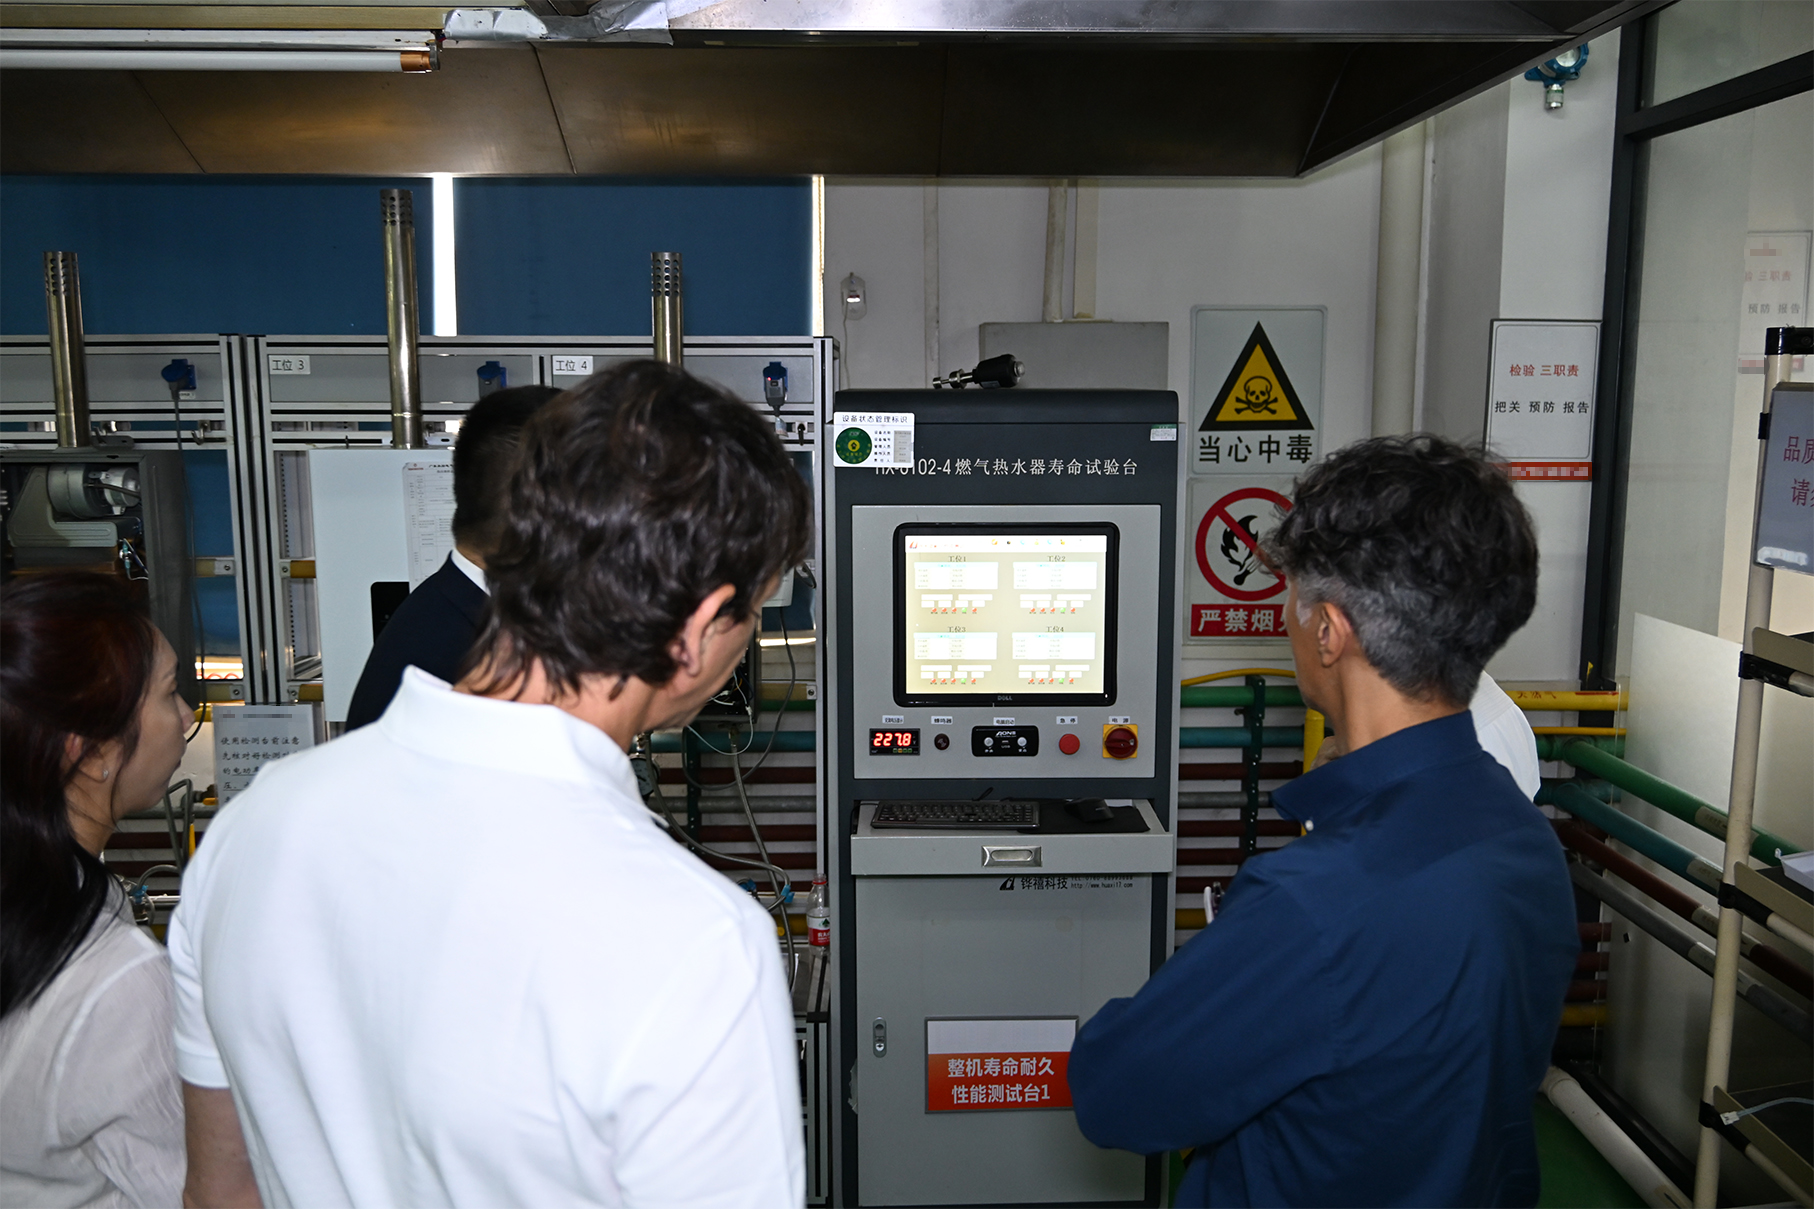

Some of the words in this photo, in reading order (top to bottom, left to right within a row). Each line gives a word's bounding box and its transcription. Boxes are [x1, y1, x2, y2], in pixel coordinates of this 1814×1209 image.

[272, 359, 293, 372] 工位
[298, 359, 305, 371] 3
[555, 360, 576, 372] 工位
[580, 360, 588, 371] 4
[1509, 364, 1536, 377] 检验
[1540, 364, 1580, 377] 三职责
[1494, 401, 1521, 414] 把关
[1529, 401, 1556, 414] 预防
[1563, 401, 1590, 414] 报告
[1198, 434, 1313, 464] 当心中毒
[954, 458, 1138, 476] 燃气热水器寿命试验台
[1791, 478, 1814, 508] 请
[873, 732, 913, 747] 227.8
[1020, 876, 1068, 890] 铧禧科技
[947, 1057, 1055, 1078] 整机寿命耐久
[951, 1083, 1051, 1104] 性能测试台1
